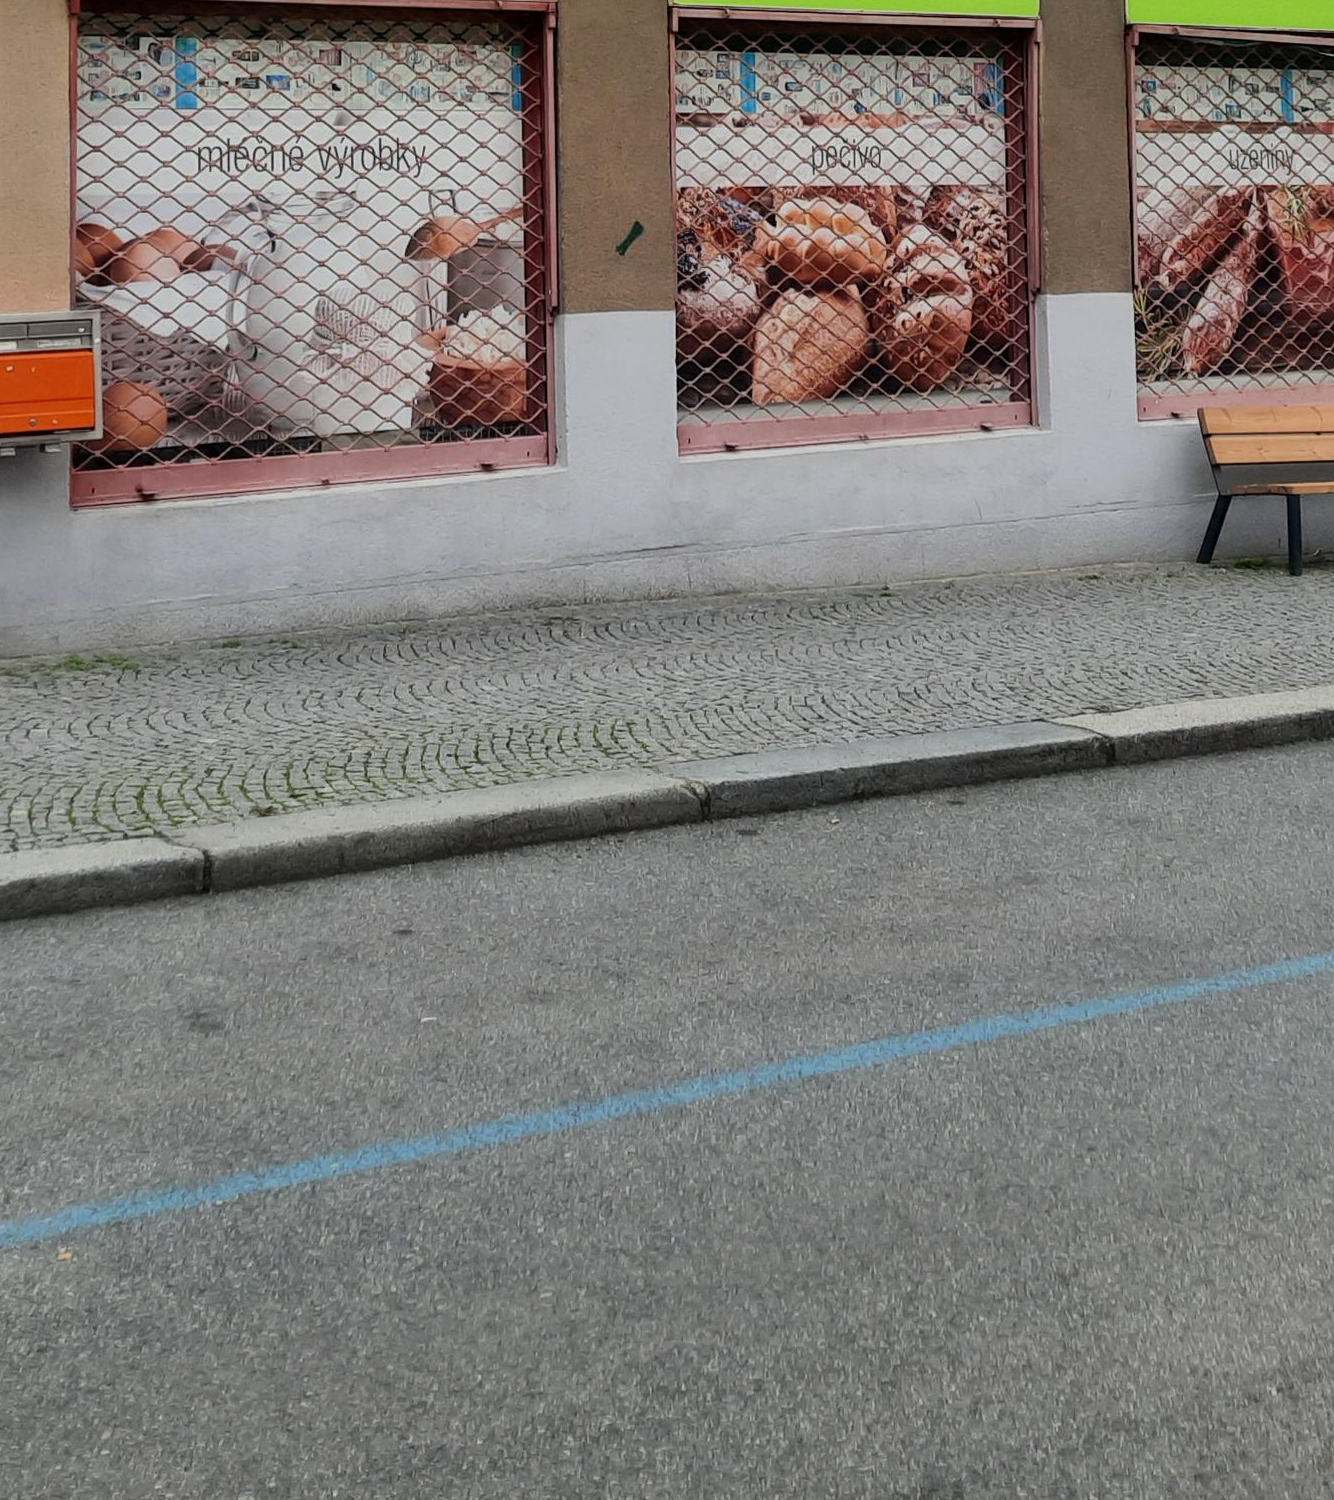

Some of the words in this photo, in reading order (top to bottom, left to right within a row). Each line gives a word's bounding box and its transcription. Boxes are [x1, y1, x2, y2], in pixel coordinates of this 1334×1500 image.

[197, 137, 304, 173] mléčné
[318, 137, 427, 179] výrobky
[812, 138, 882, 175] pečivo
[1228, 141, 1294, 174] uzeniny
